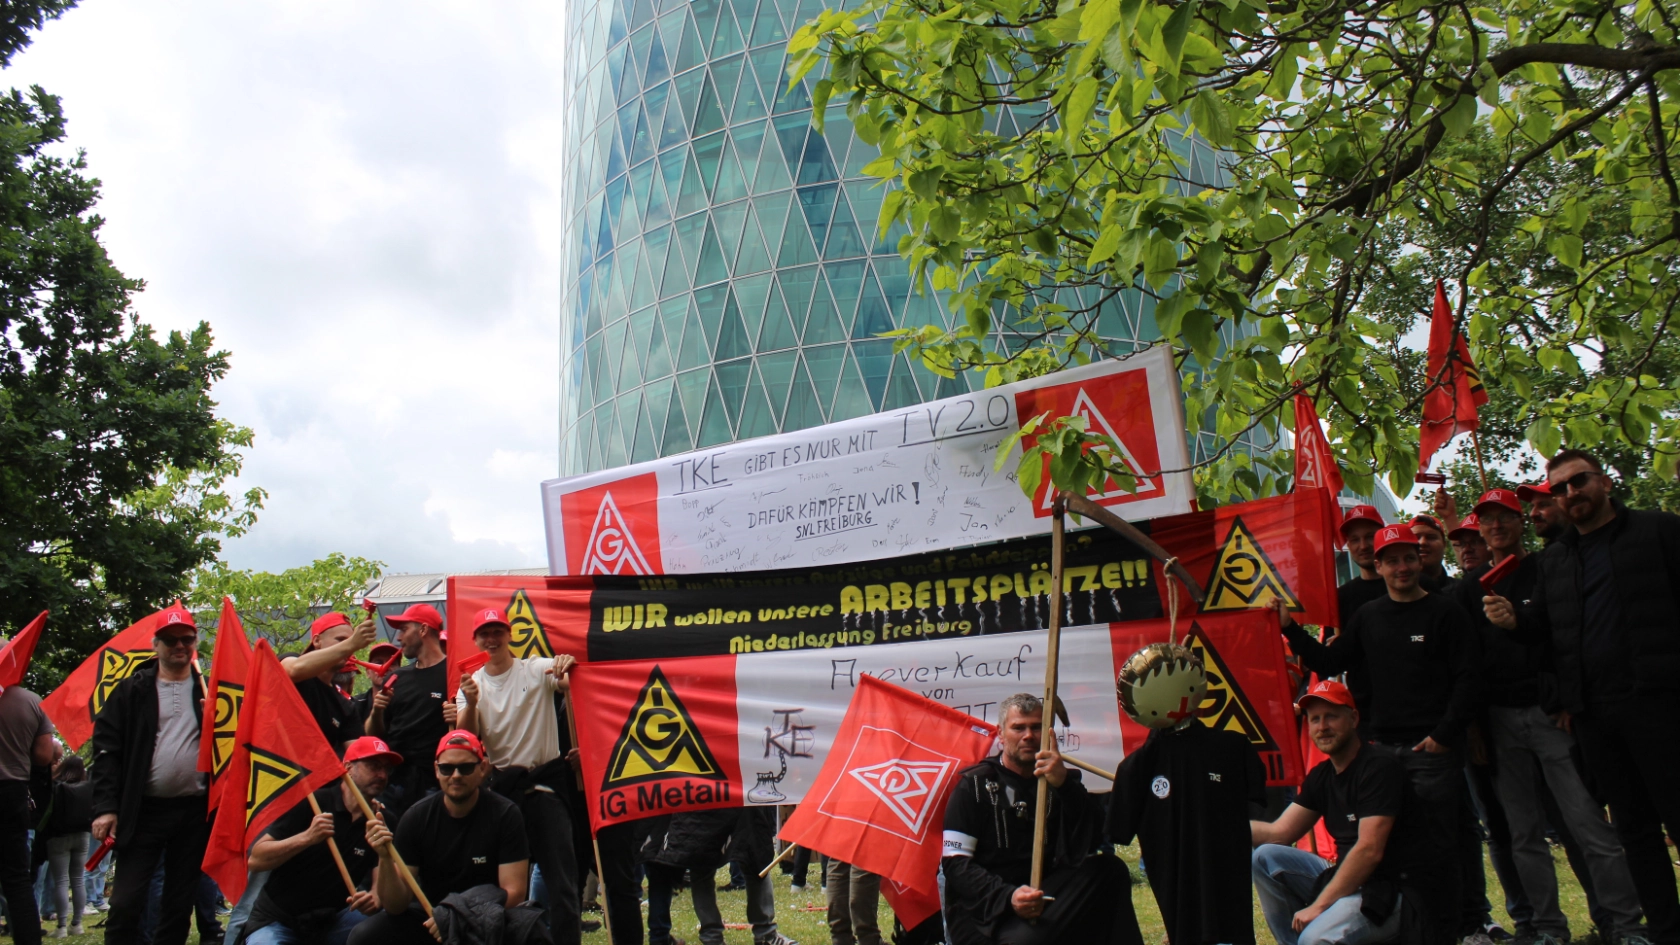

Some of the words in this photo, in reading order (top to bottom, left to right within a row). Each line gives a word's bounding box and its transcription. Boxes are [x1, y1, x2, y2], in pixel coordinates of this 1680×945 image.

[672, 452, 728, 492] TKE
[744, 451, 776, 475] GIBT
[783, 446, 801, 467] ES
[806, 438, 841, 462] NUR
[848, 430, 878, 454] MIT
[957, 395, 1009, 432] 2.0
[748, 505, 795, 528] DAFÜR
[799, 492, 867, 519] KÄMPFEN
[602, 603, 668, 632] WIR
[674, 608, 751, 627] wollen
[757, 604, 834, 623] unsere
[729, 628, 876, 655] Niederlassung
[882, 620, 972, 641] Freiburg
[637, 781, 731, 813] Metall
